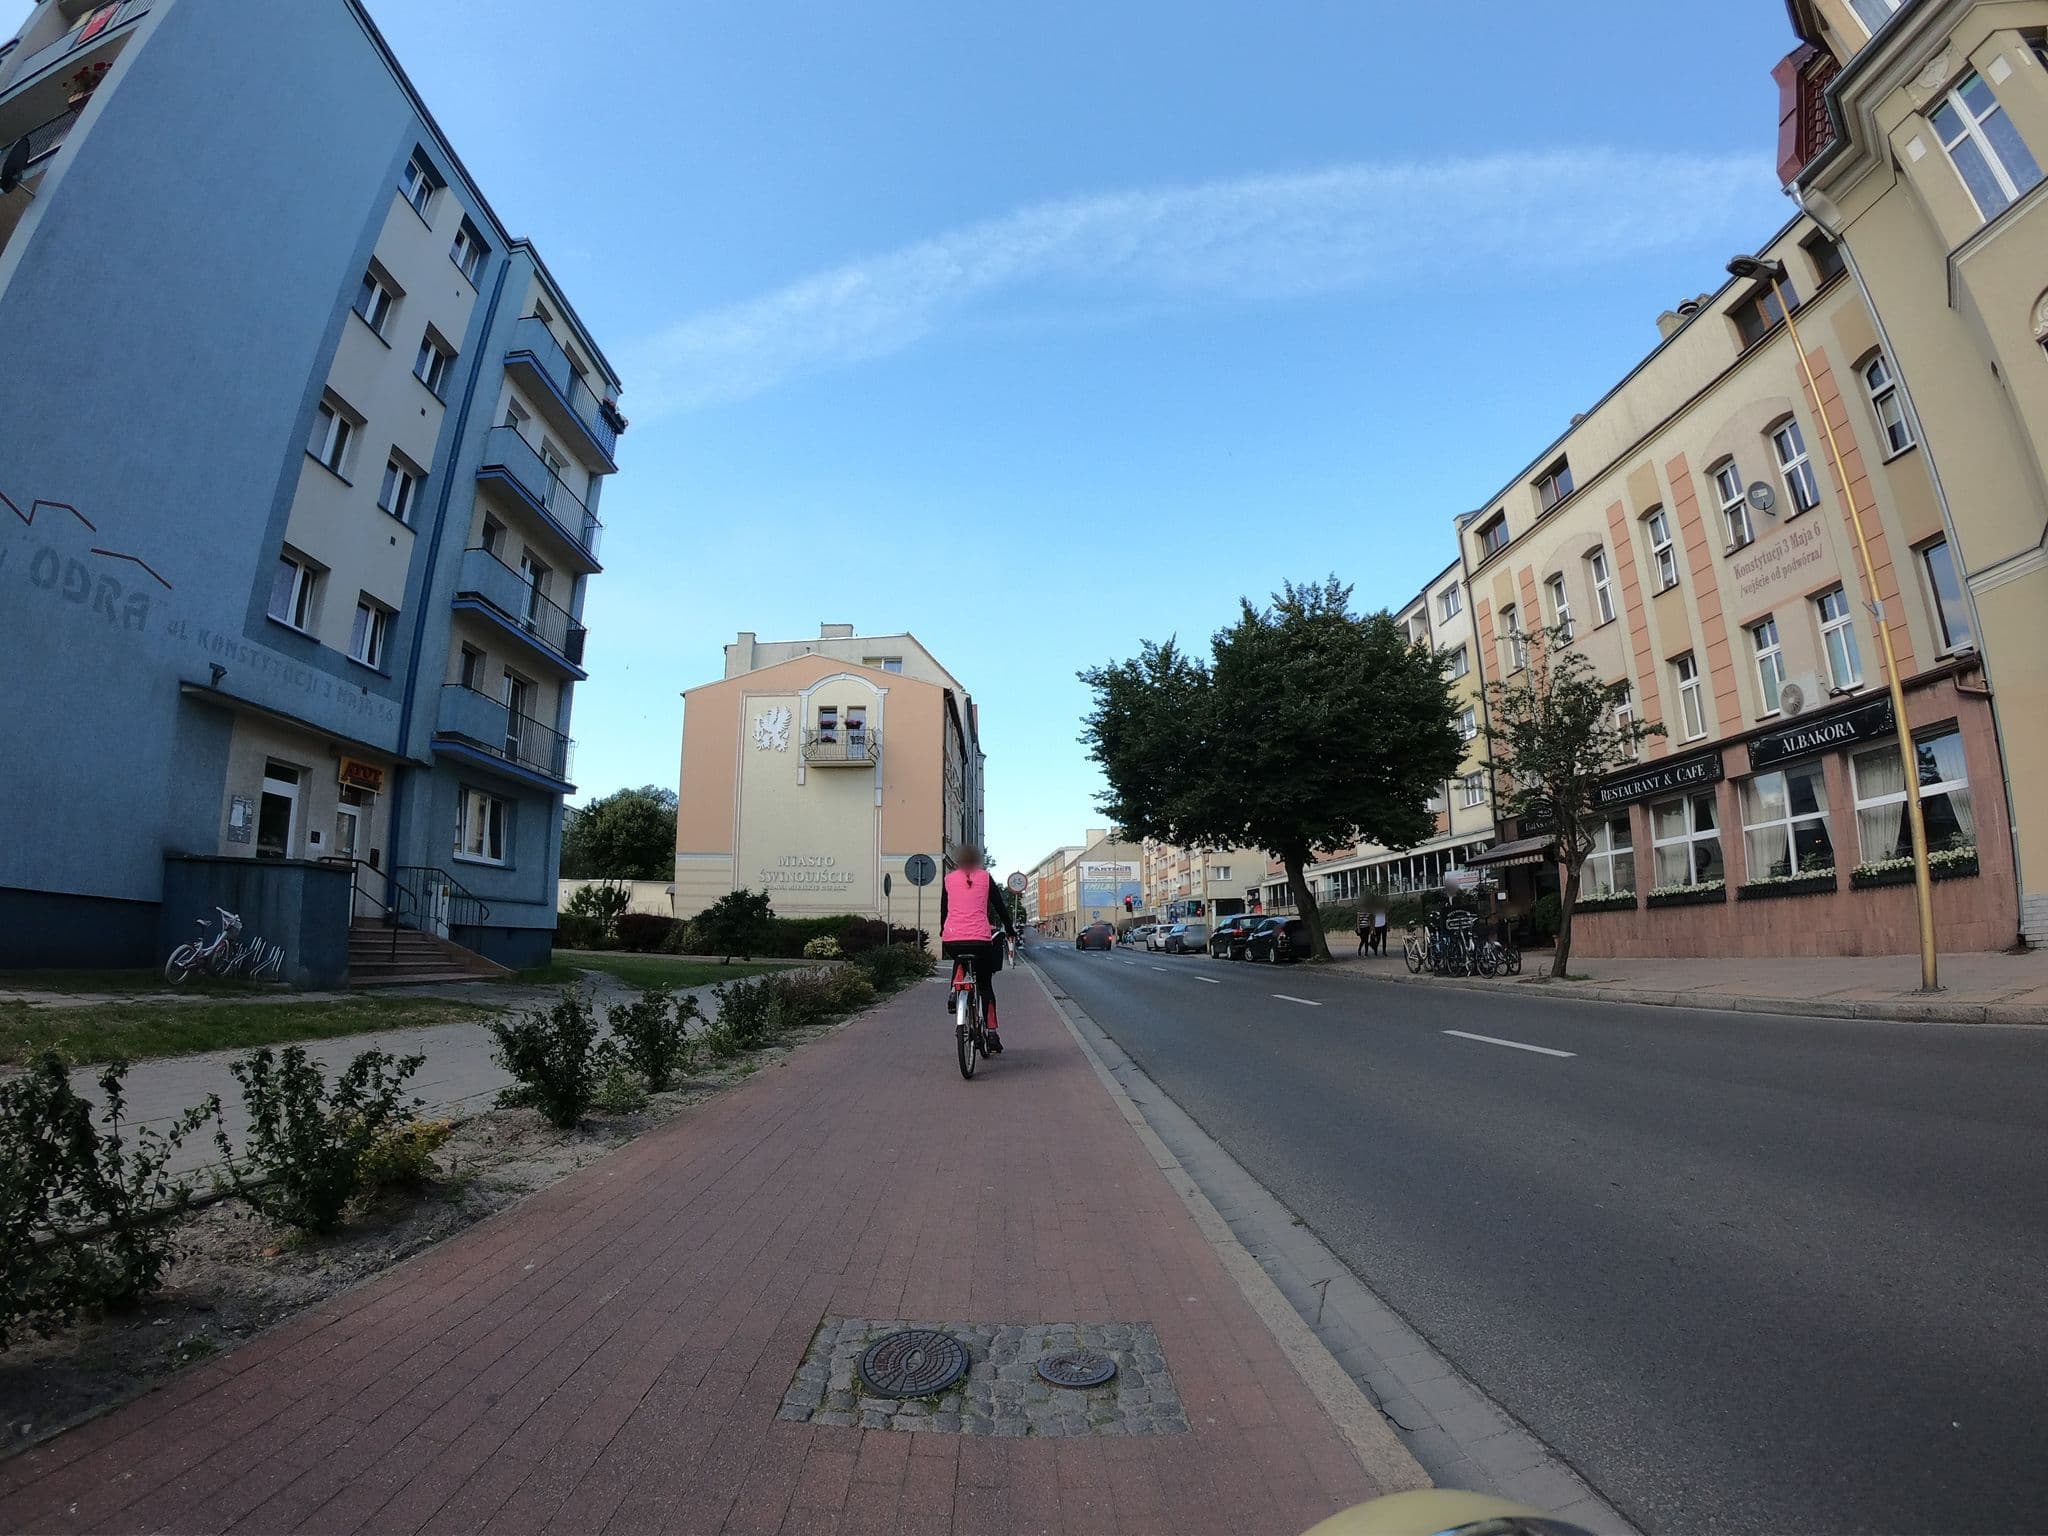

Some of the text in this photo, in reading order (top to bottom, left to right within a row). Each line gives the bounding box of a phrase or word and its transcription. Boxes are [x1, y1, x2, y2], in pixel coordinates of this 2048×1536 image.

[1733, 521, 1821, 580] Konstytucji 3 Maja 6
[1771, 566, 1782, 583] od
[1781, 720, 1856, 754] ALBAKORA
[1600, 776, 1661, 802] RESTAURANT
[1664, 773, 1673, 786] &
[777, 855, 836, 867] MIASTO
[759, 868, 854, 883] ŚWINOUJŚCIE
